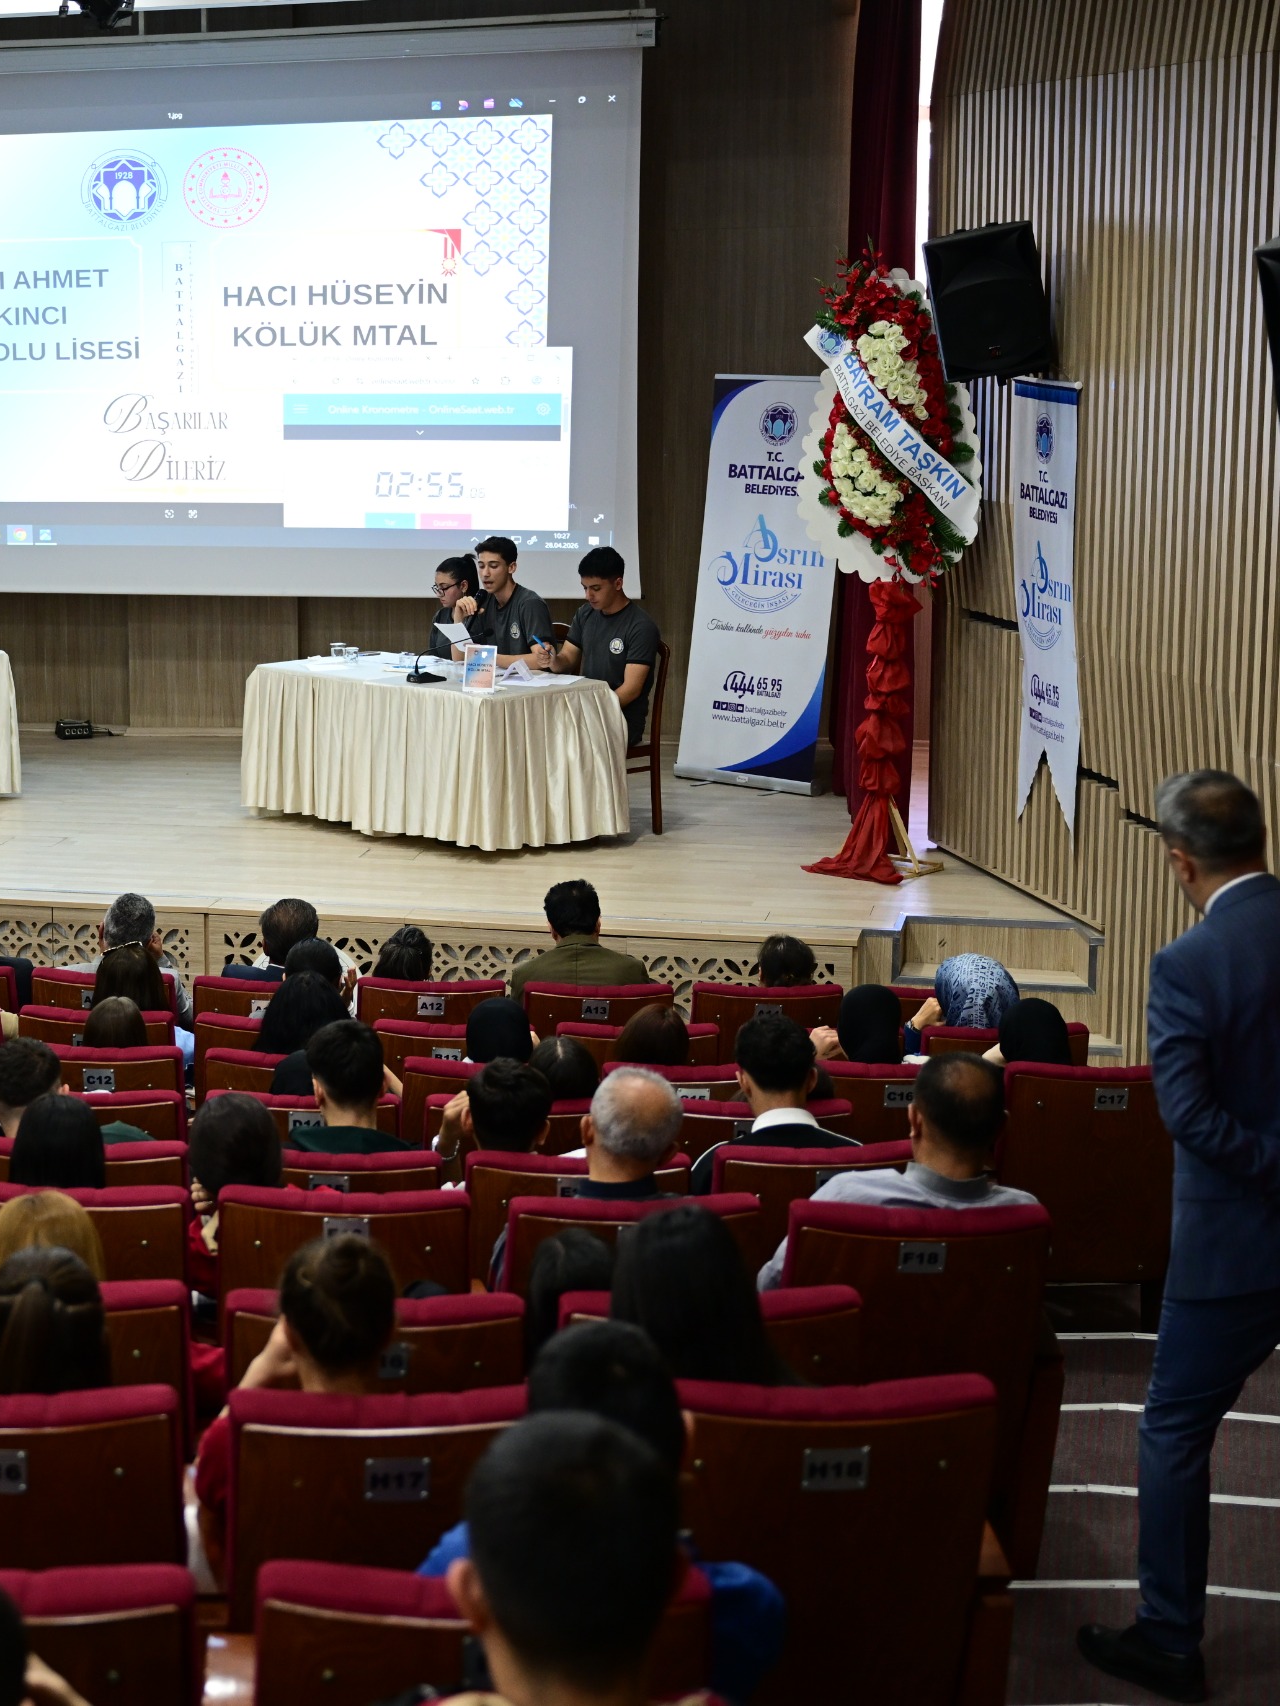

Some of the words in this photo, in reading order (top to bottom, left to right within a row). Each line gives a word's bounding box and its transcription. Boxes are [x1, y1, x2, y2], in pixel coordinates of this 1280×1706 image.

[115, 171, 133, 180] 1928
[13, 269, 109, 289] AHMET
[223, 285, 296, 307] HACI
[308, 278, 448, 306] HÜSEYİN
[233, 321, 342, 347] KÖLÜK
[353, 324, 438, 346] MTAL
[55, 337, 140, 360] LİSESİ
[104, 393, 228, 435] BAŞARILAR
[844, 353, 901, 434] BAYRAM
[897, 428, 967, 500] TAŞKIN
[833, 362, 869, 422] BATTALGAZİ
[864, 419, 910, 470] BELEDİYE
[906, 465, 951, 511] BAŞKANI
[119, 439, 226, 481] DİLERİZ
[766, 451, 784, 462] T.C.
[728, 463, 805, 482] BATTALGA
[744, 483, 800, 497] BELEDİYES
[553, 532, 571, 540] 10:27
[730, 673, 755, 696] 444
[756, 676, 768, 691] 65
[770, 678, 783, 692] 95
[420, 1002, 442, 1011] A12
[584, 1005, 607, 1015] A13
[86, 1075, 112, 1085] C12
[886, 1091, 915, 1102] C16
[1097, 1094, 1125, 1105] C17
[902, 1251, 939, 1265] F18
[369, 1471, 425, 1490] H17
